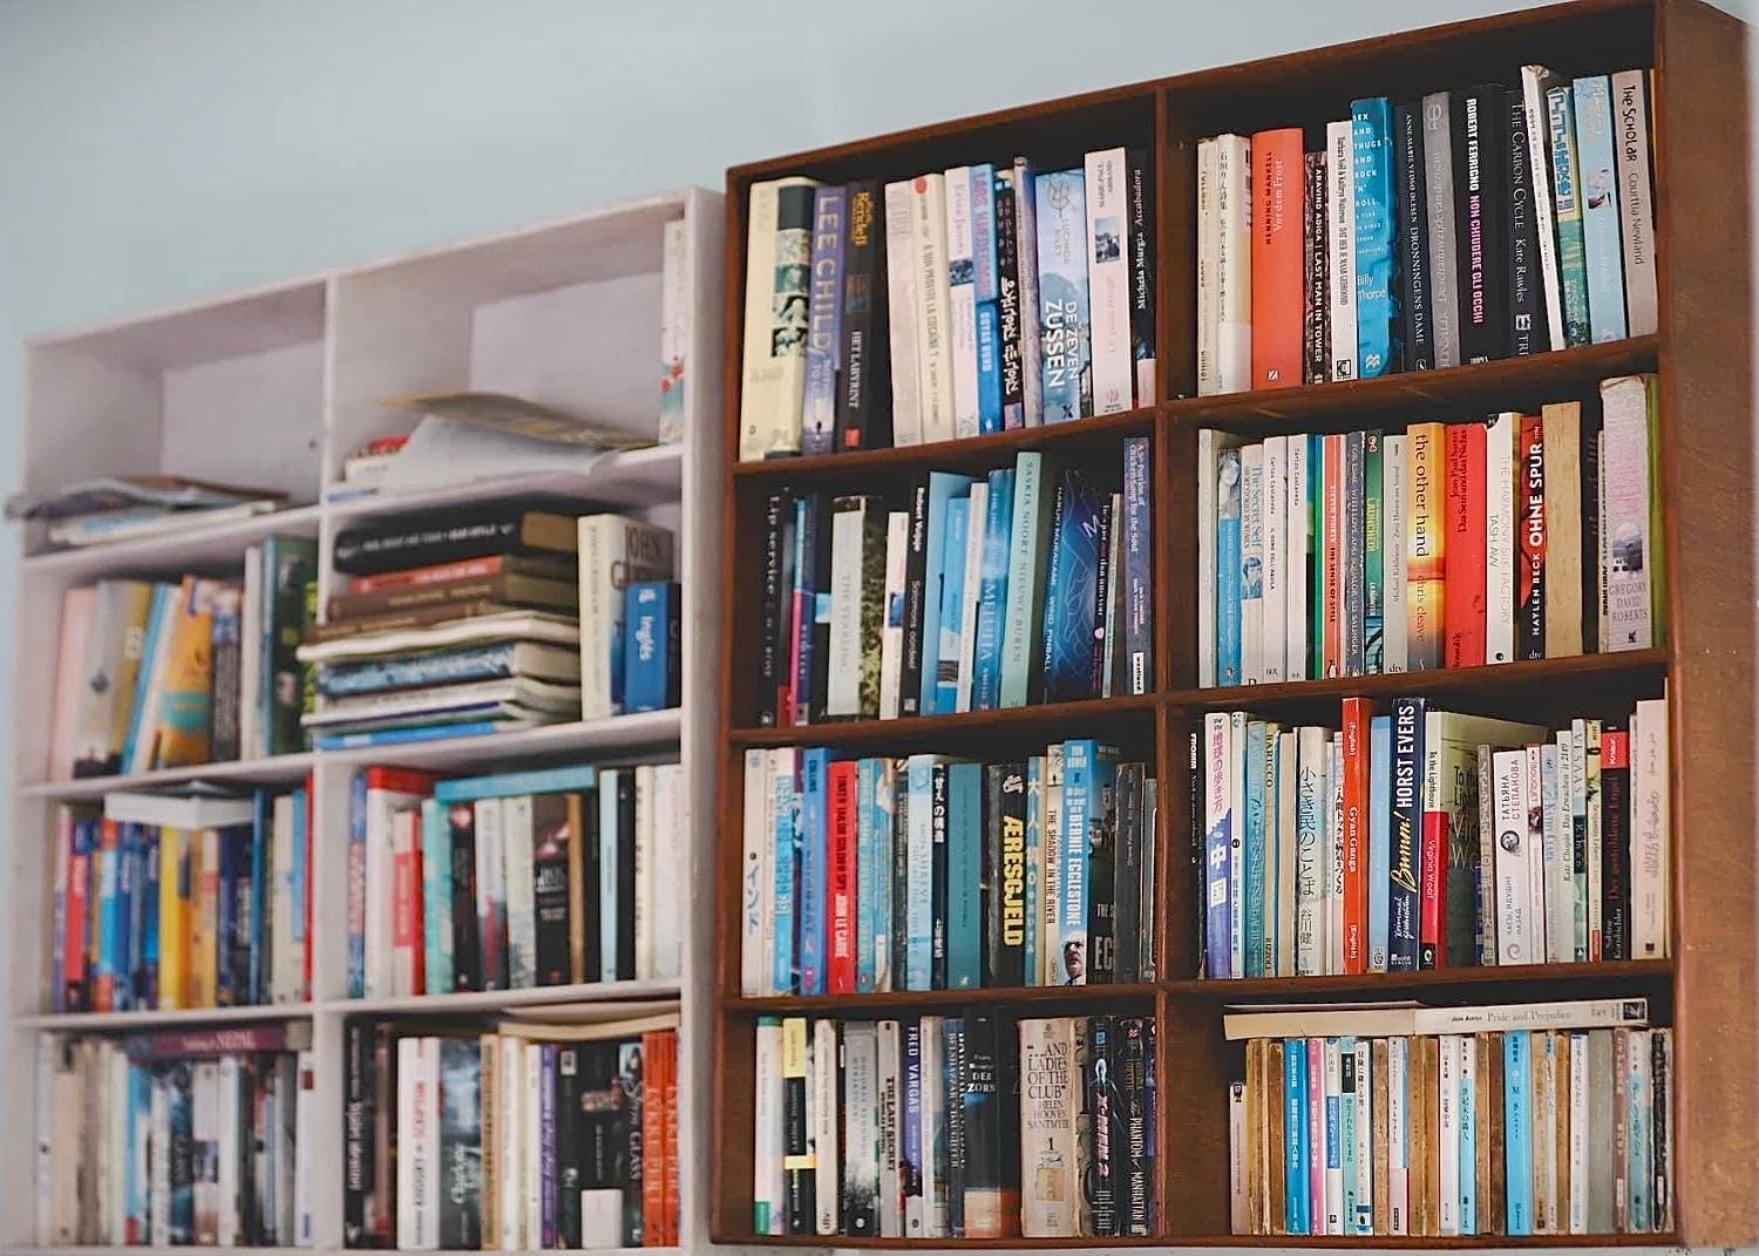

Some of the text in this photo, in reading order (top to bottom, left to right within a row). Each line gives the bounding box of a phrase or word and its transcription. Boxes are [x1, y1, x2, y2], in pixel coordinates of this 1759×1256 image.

[854, 191, 870, 246] Rendell
[1467, 99, 1484, 323] ROBERT FERRIGNO NON CHIUDERE GLI OCCHI
[1511, 101, 1527, 303] THE CARBON CYCLE Kate Rawles
[1132, 169, 1147, 308] Michela Murgia Accabadora
[1632, 218, 1646, 265] Newland
[813, 196, 840, 350] LEE CHILD
[1314, 169, 1324, 362] ARAVIND ADIGA LAST MAN IN TOWER
[1357, 273, 1374, 287] Billy
[1410, 226, 1423, 310] DRONNINGENS
[926, 304, 937, 314] LA
[1414, 314, 1425, 344] DAME
[1046, 299, 1064, 387] ZUSSEN
[1065, 301, 1079, 379] DE ZEVEN
[849, 331, 862, 409] HET LABYRINT
[1416, 434, 1429, 462] the
[1055, 486, 1063, 526] HARUKI
[1415, 465, 1429, 510] other
[766, 496, 780, 594] Lip service
[1415, 515, 1430, 557] hand
[1489, 515, 1499, 568] TASH AW
[1500, 457, 1511, 624] THE HARMONY SILK FACTORY
[1529, 442, 1543, 635] HAYLEN BECK OHNE SPUR
[1013, 461, 1034, 662] SASKIA NOORT NIEUWE BUREN
[909, 580, 921, 628] Salomons
[1047, 597, 1057, 625] WIND
[1330, 589, 1336, 599] OF
[980, 583, 996, 661] MELUHA
[1416, 606, 1427, 642] cleave
[1044, 629, 1055, 673] PINBALL
[1396, 706, 1415, 754] EVERS
[1265, 734, 1274, 788] BARICCO
[1395, 759, 1413, 808] HORST
[1429, 759, 1438, 770] the
[1427, 771, 1438, 808] Lighthouse
[1501, 774, 1510, 821] ТАТЬЯНА
[1510, 758, 1520, 820] СТЕПАНОВА
[1048, 829, 1056, 864] SHADOW
[1348, 721, 1358, 959] (English) Gyan Ganga (English)
[1427, 840, 1438, 870] Virginia
[1003, 816, 1024, 946] ÆRESGJELD
[1047, 881, 1056, 897] THE
[1048, 868, 1056, 878] IN
[1066, 813, 1083, 926] BERNIE ECCLESTONE
[1427, 873, 1437, 899] Woolf
[1046, 900, 1056, 924] RIVER
[908, 1026, 920, 1113] FRED VARGAS
[1027, 1057, 1067, 1071] LADIES
[1027, 1070, 1069, 1085] OF THE
[886, 1077, 896, 1172] THE LAST SECRET
[1048, 1137, 1054, 1150] 1
[1096, 1092, 1109, 1177] X-MEN 2
[1129, 1117, 1144, 1221] PHANTOM MANHATTAN
